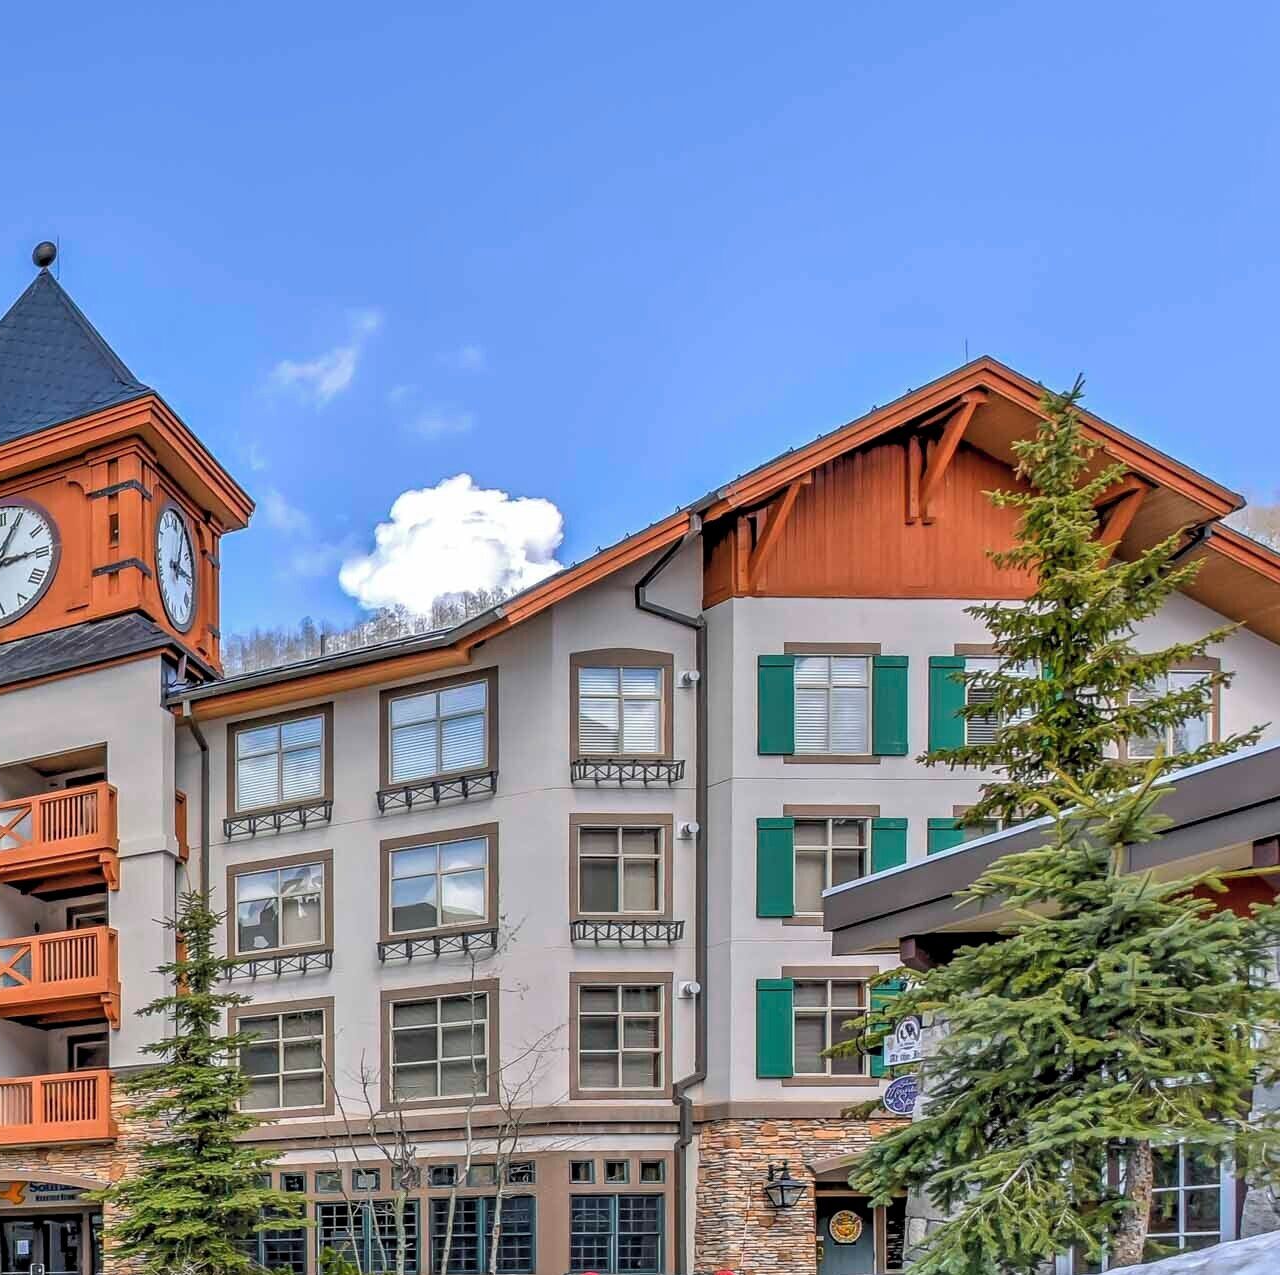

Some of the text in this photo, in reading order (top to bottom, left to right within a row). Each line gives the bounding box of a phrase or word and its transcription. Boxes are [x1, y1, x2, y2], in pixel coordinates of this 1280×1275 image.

[30, 525, 43, 538] II
[36, 546, 49, 559] III
[17, 593, 28, 605] V
